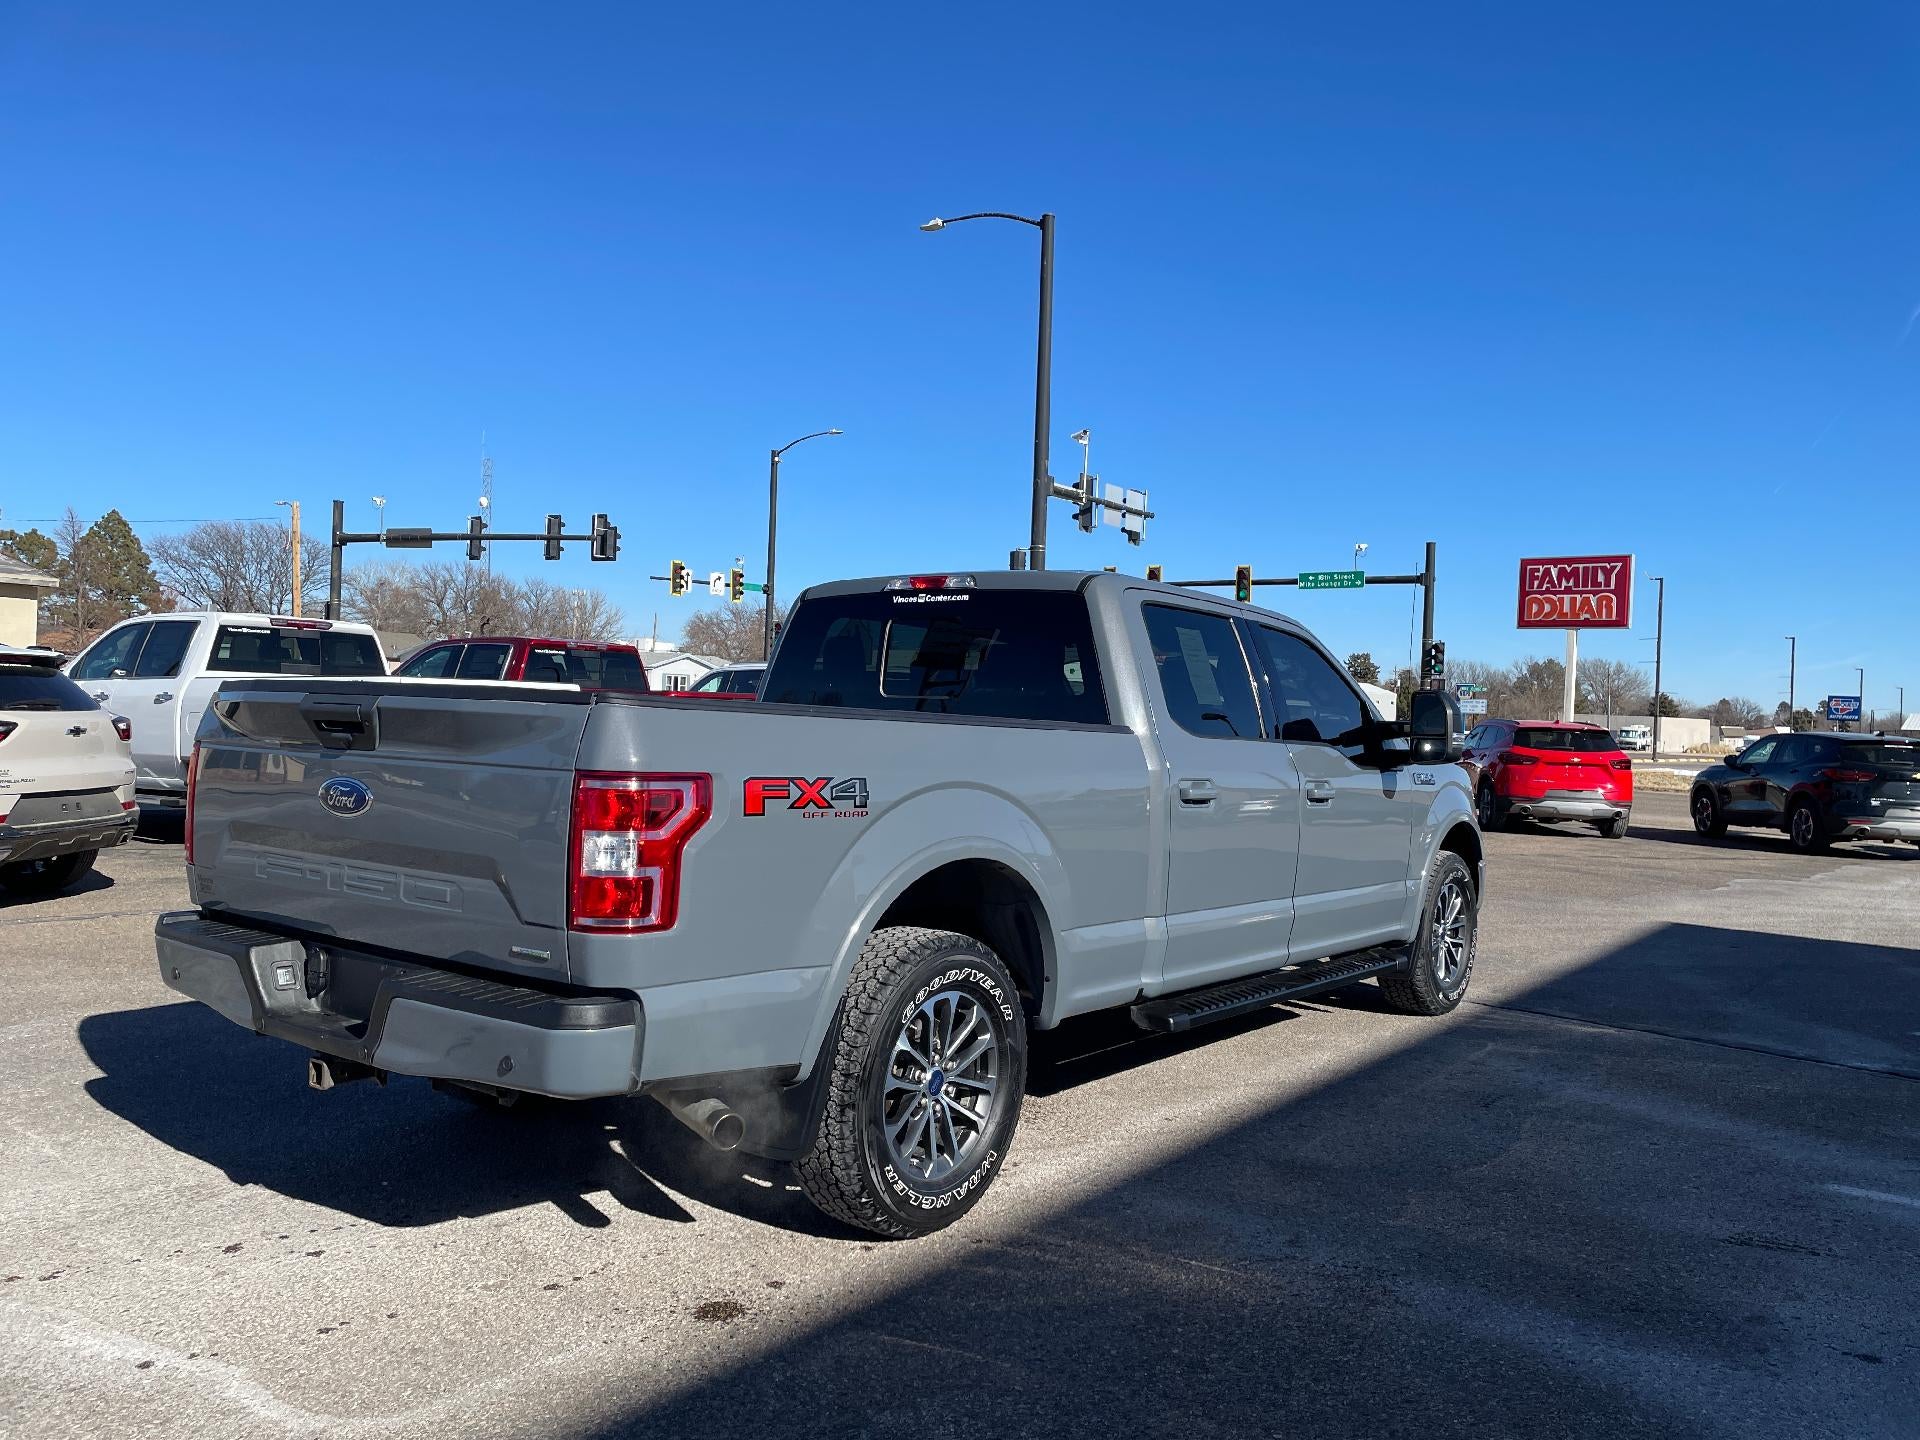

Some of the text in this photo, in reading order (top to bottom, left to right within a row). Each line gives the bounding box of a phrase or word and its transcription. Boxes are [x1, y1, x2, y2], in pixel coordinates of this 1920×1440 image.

[1525, 563, 1622, 591] FAMILY
[1524, 592, 1617, 621] DOLLAR
[328, 785, 358, 809] Ford
[743, 776, 870, 817] FX4
[901, 967, 1013, 1024] GOODYEAR
[884, 1150, 997, 1210] WRANGLER
